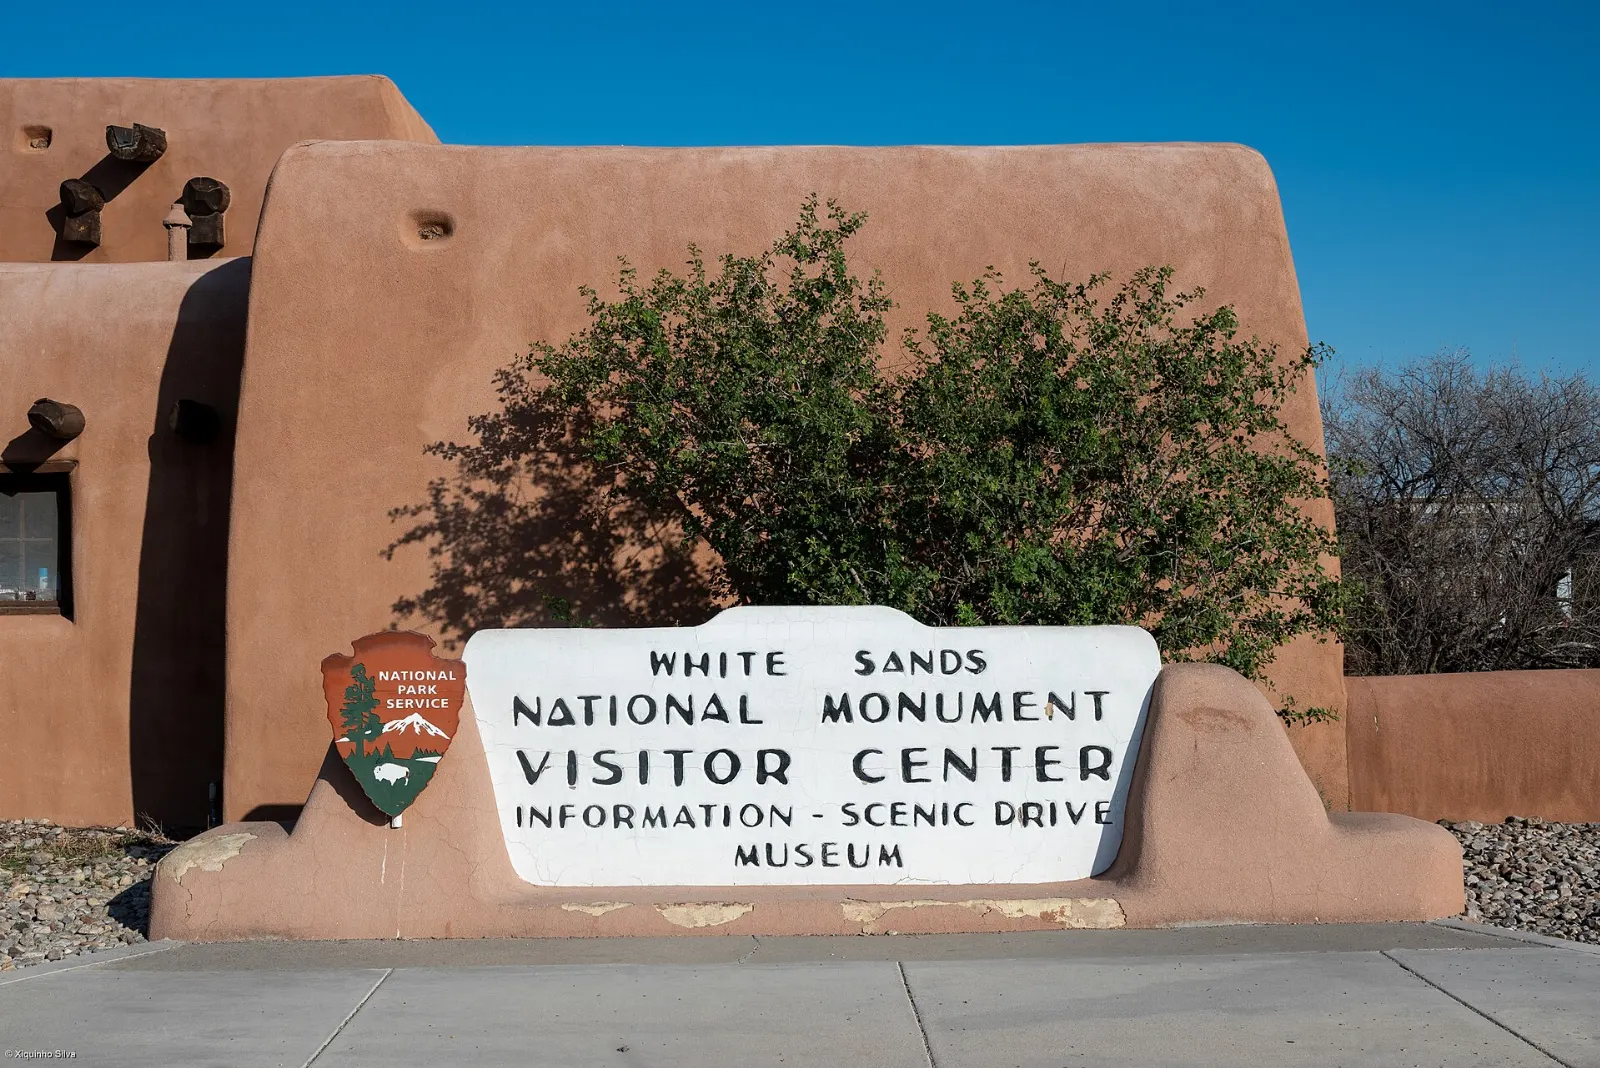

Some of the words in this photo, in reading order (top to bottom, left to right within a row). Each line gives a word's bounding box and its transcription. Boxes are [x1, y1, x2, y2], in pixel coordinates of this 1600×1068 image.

[378, 670, 457, 681] NATIONAL
[650, 651, 787, 678] WHITE
[854, 649, 987, 676] SANDS
[397, 684, 438, 695] PARK
[386, 698, 449, 709] SERVICE
[513, 693, 763, 727] NATIONAL
[821, 691, 1110, 724] MONUMENT
[516, 749, 791, 787] VISITOR
[852, 745, 1113, 784] CENTER
[516, 804, 793, 829] INFORMATION
[841, 802, 975, 827] SCENIC
[994, 801, 1113, 828] DRIVE
[734, 843, 903, 868] MUSEUM
